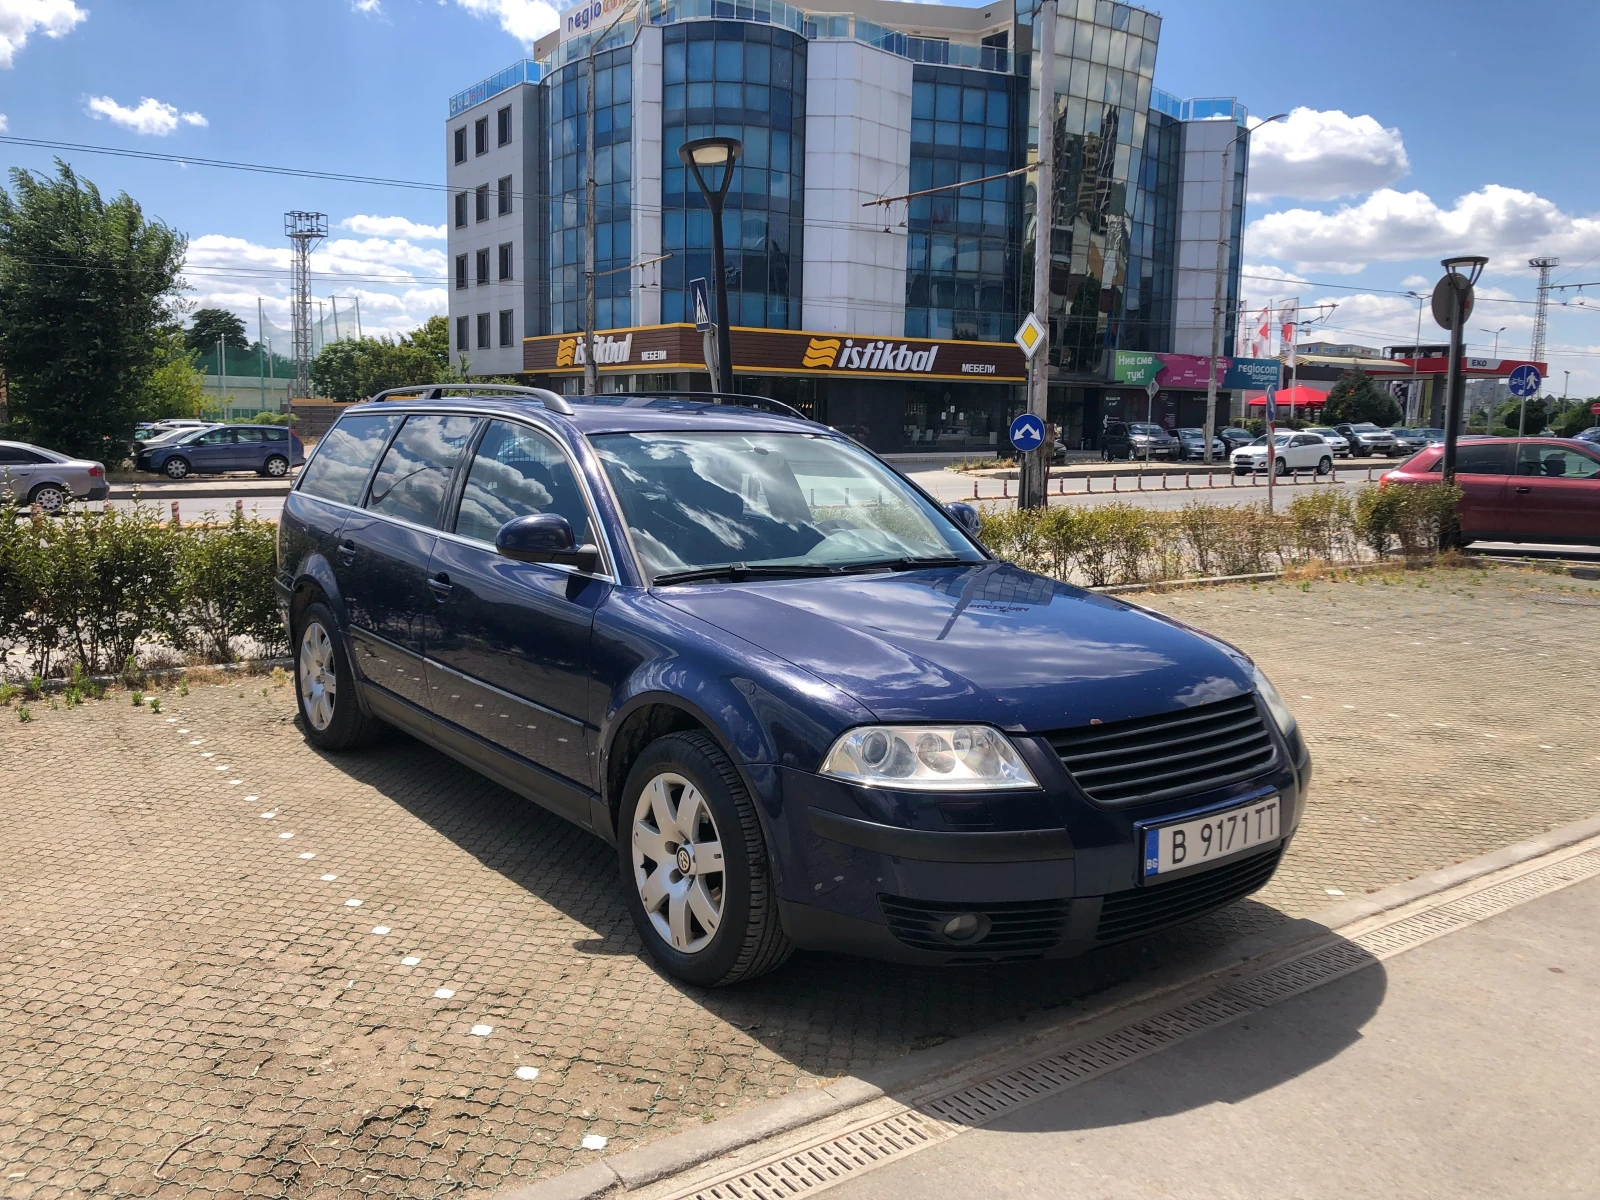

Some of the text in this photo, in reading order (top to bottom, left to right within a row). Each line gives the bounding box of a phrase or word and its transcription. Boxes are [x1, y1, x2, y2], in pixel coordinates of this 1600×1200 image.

[573, 333, 633, 365] isikbal
[641, 350, 667, 361] МЕБЕЛИ
[838, 339, 939, 372] istikbal
[1118, 355, 1153, 366] Ние сме
[961, 363, 996, 374] МЕБЕЛИ
[1238, 363, 1278, 375] regiocom
[1471, 359, 1488, 367] EKO
[1126, 368, 1145, 381] тук!
[1146, 858, 1158, 870] BG
